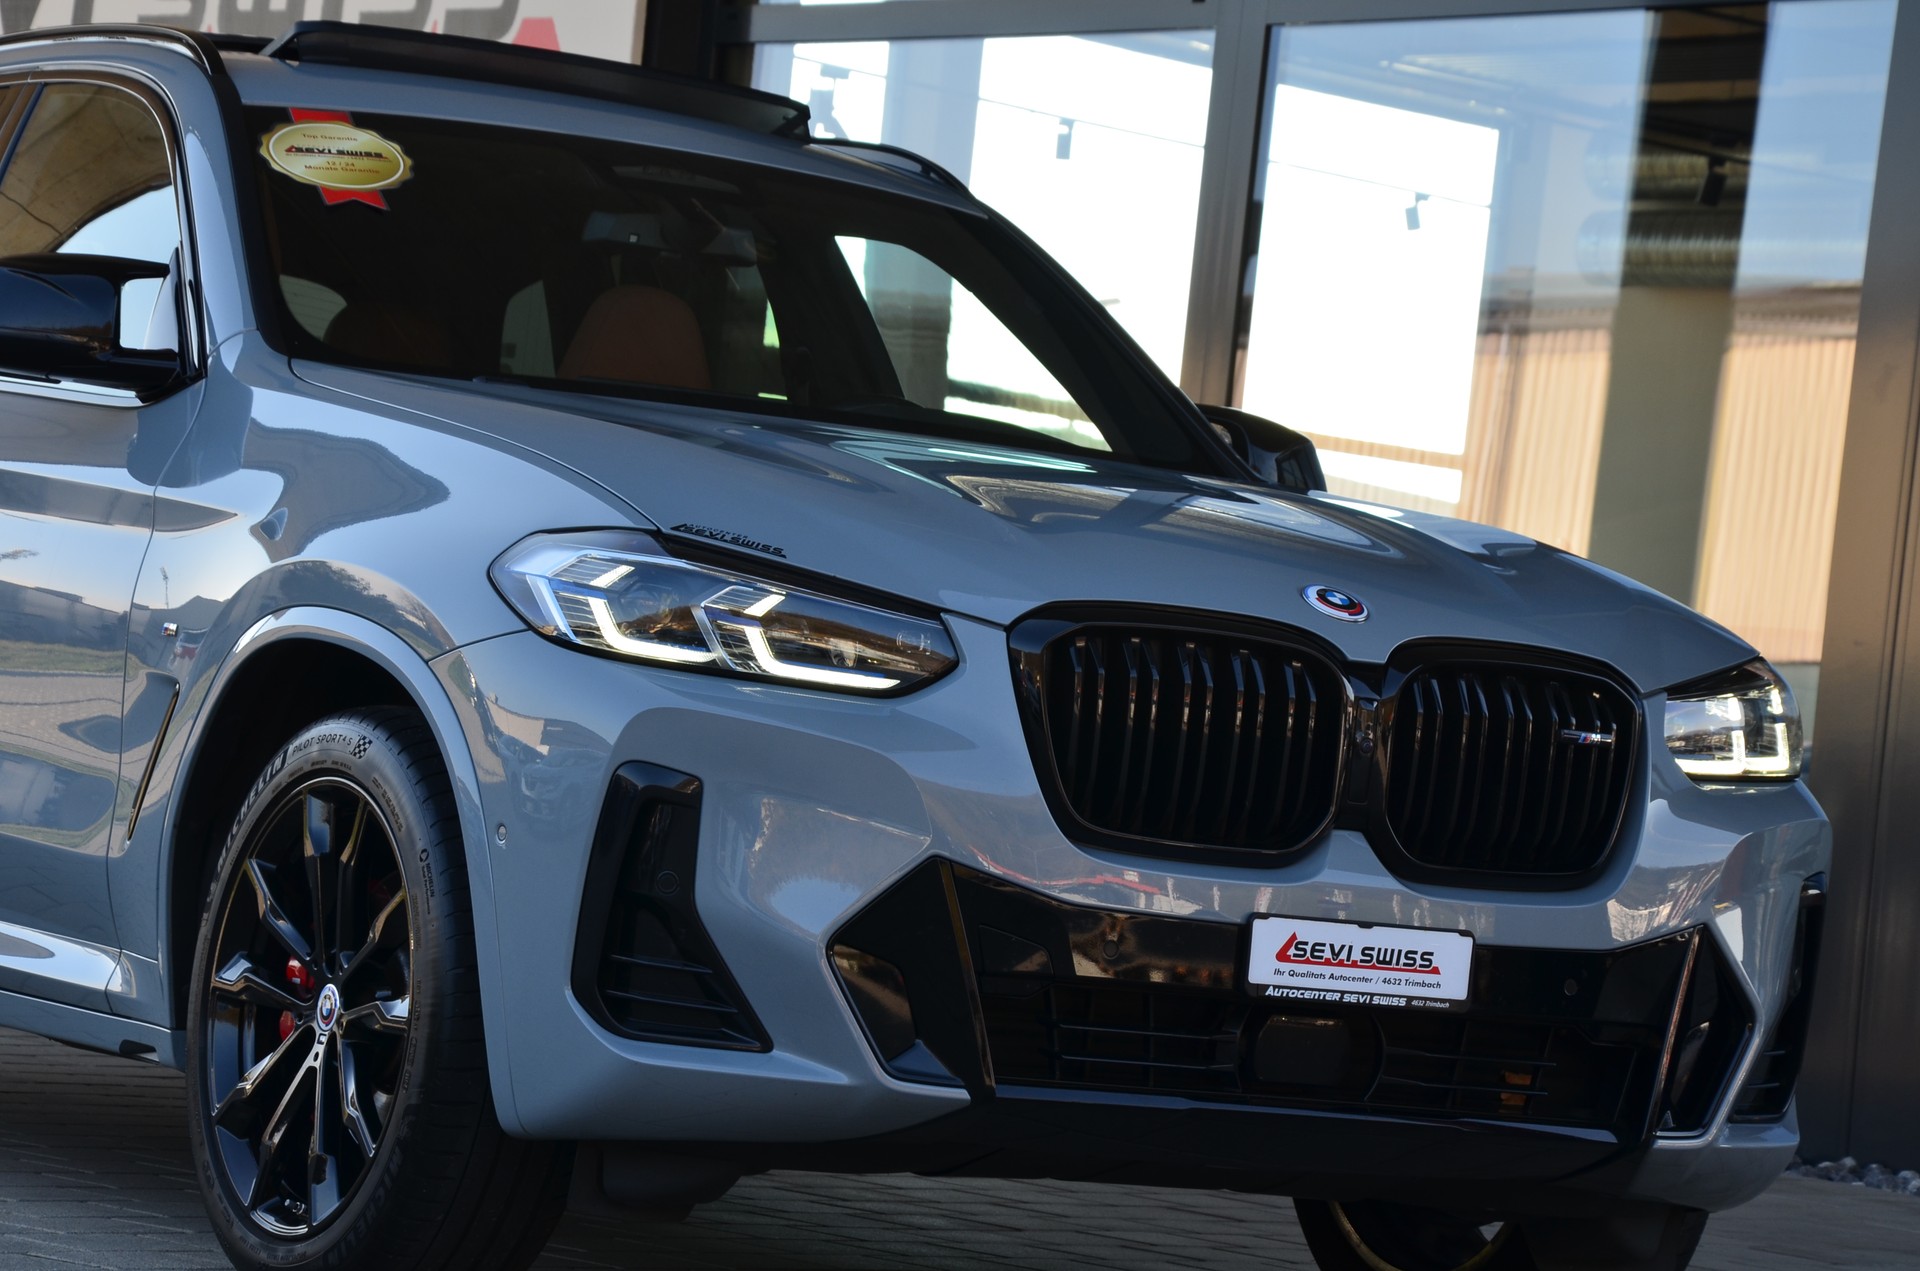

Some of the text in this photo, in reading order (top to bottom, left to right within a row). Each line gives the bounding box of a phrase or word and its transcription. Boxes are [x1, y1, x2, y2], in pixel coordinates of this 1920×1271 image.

[320, 134, 358, 142] Garantie
[336, 149, 384, 159] SWISS
[304, 164, 380, 174] Monate Garantie
[729, 536, 784, 555] SWISS
[292, 736, 315, 757] PILOT
[425, 862, 436, 898] MICHELIN
[1292, 940, 1435, 969] SEVI SWISS
[1273, 968, 1286, 976] Ihr
[1288, 969, 1326, 980] Qualitats
[1328, 973, 1374, 984] Autocenter
[1382, 977, 1402, 986] 4632
[1404, 978, 1441, 989] Trimbach
[1342, 993, 1370, 1004] SEVI
[1371, 995, 1407, 1007] SWISS
[1411, 999, 1425, 1007] 4632
[1425, 1000, 1450, 1009] Trimbach
